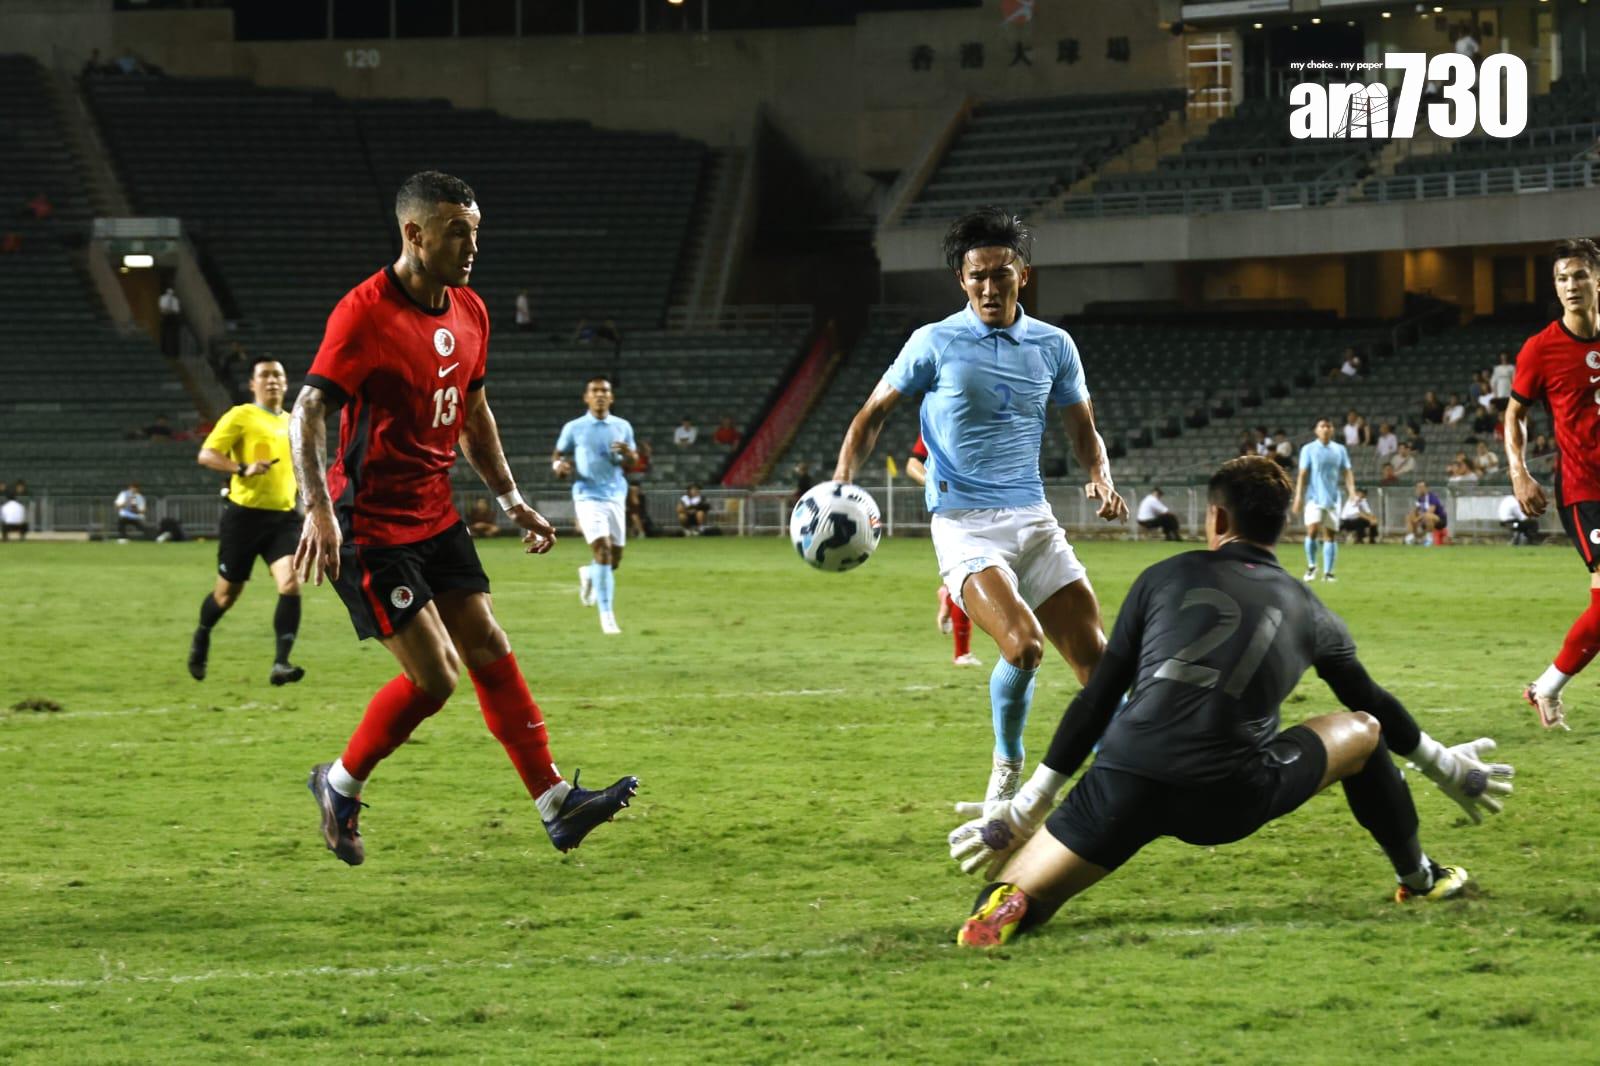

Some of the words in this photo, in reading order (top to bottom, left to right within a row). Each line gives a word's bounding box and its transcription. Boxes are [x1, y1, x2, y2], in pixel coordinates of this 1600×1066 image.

[344, 48, 380, 68] 120
[432, 386, 458, 429] 13
[992, 383, 1013, 420] 2
[1153, 587, 1283, 700] 21
